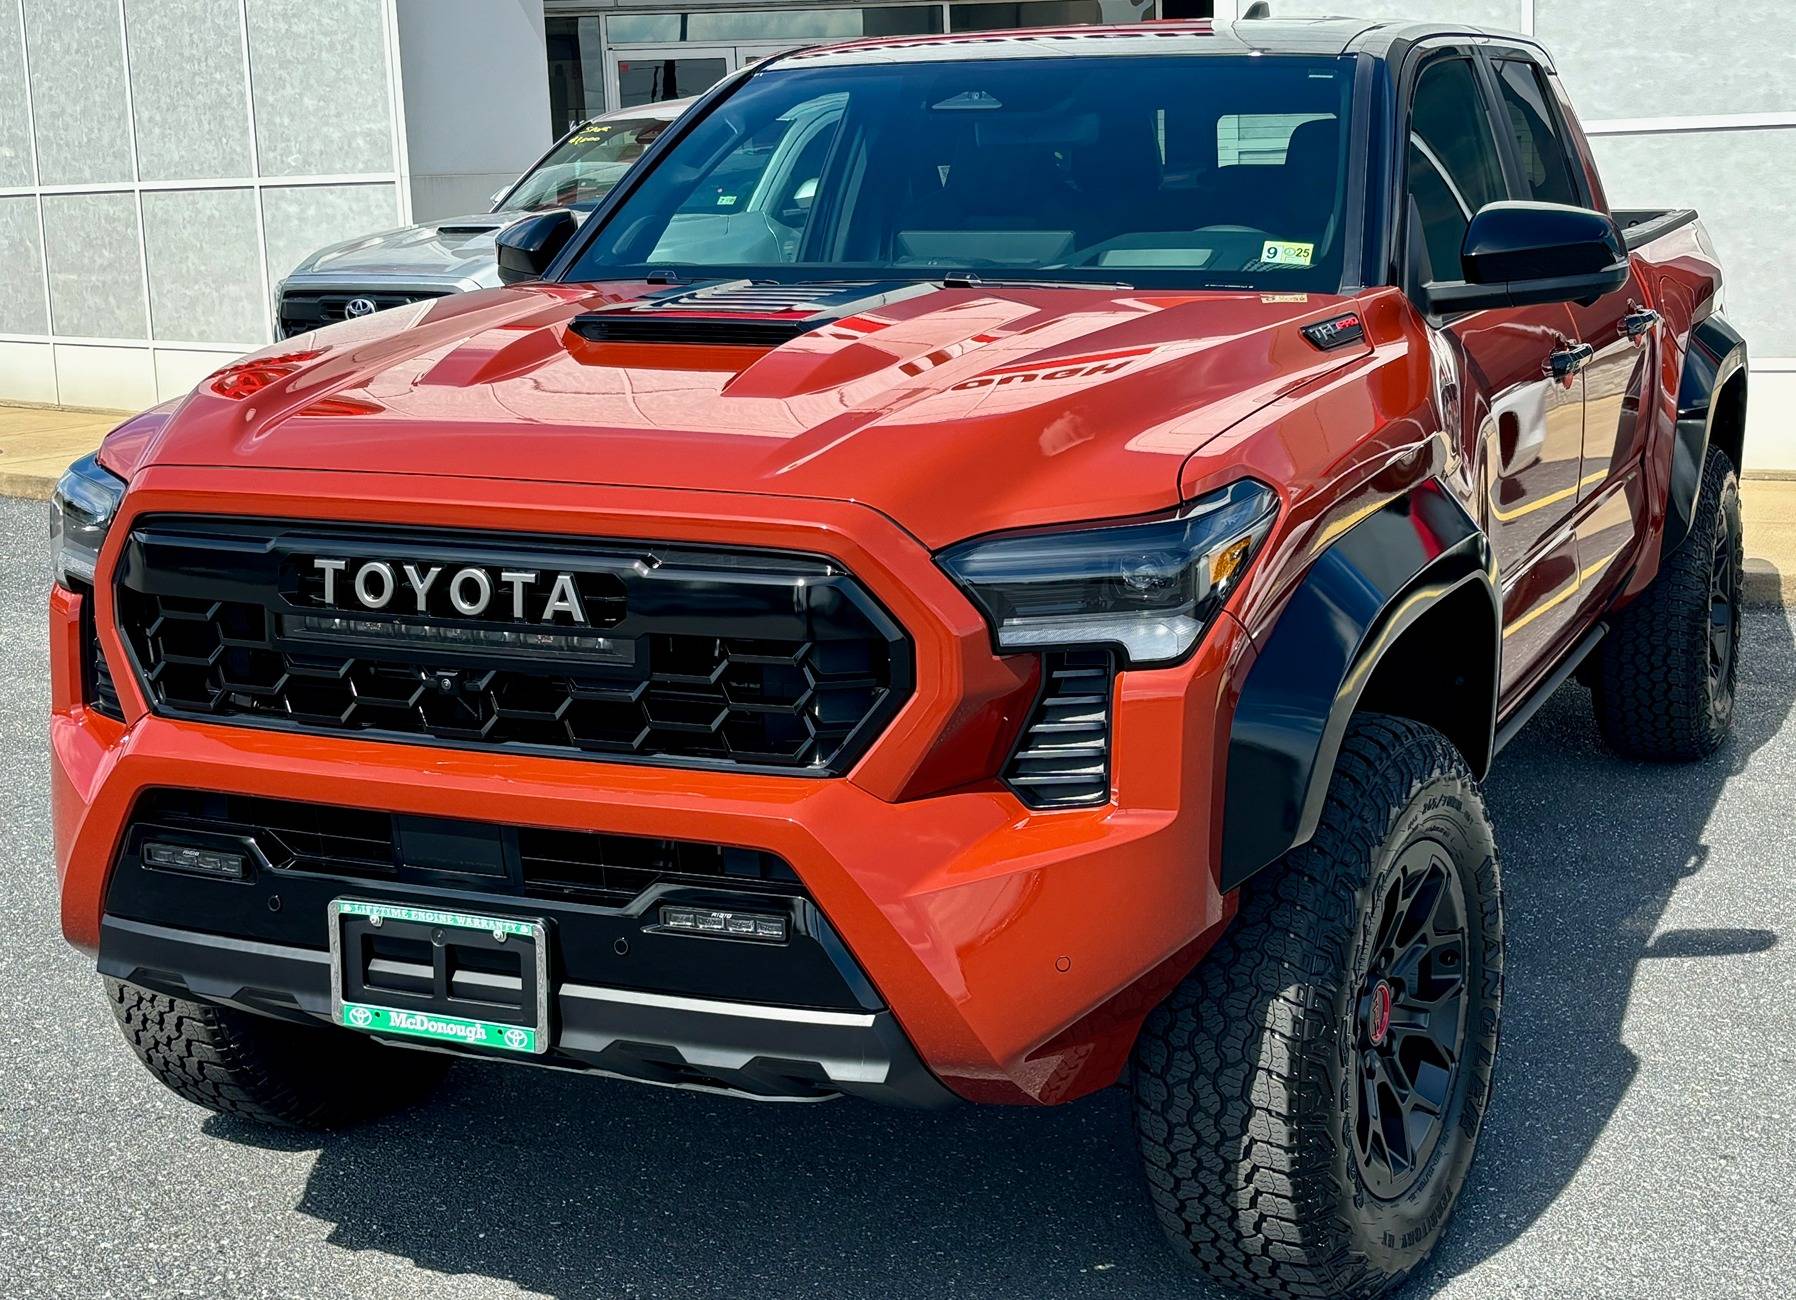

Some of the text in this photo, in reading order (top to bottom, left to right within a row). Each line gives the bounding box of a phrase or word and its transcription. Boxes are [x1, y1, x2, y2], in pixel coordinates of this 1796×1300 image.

[1267, 246, 1310, 259] 9 25
[314, 559, 586, 624] TOYOTA
[355, 904, 519, 932] LIFETIME ENGINE WARRANTY
[1459, 855, 1501, 1139] WRANGLER
[389, 1012, 487, 1042] McDonough
